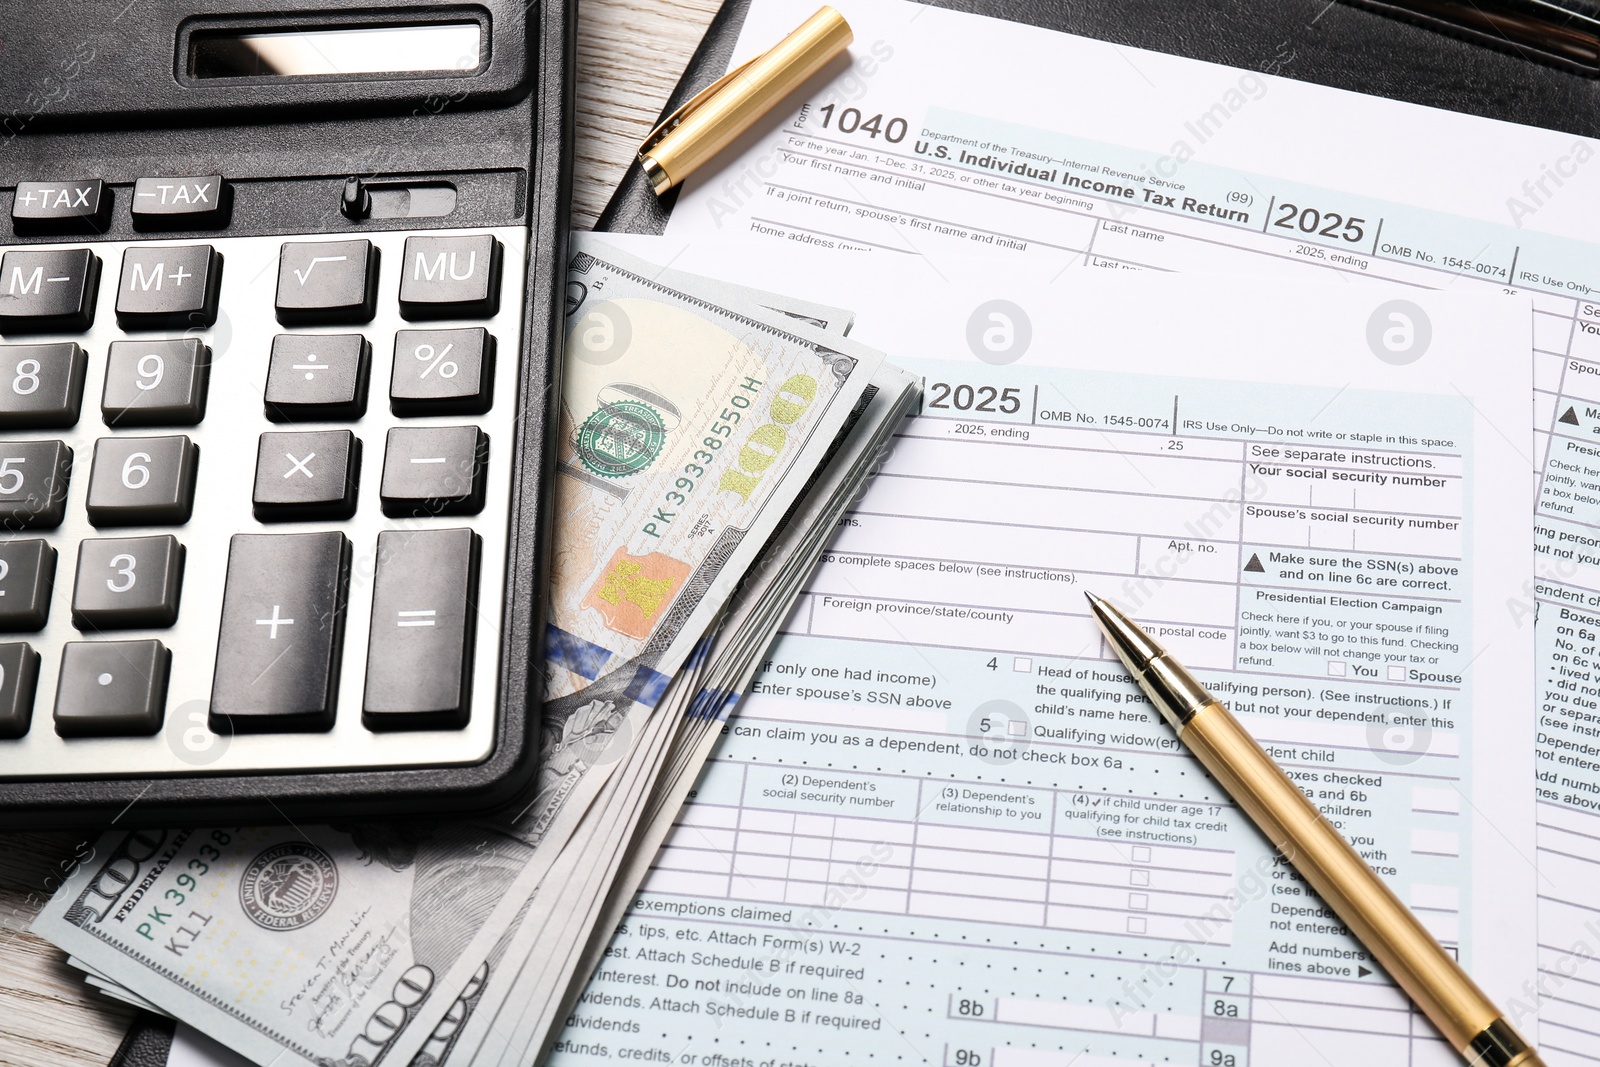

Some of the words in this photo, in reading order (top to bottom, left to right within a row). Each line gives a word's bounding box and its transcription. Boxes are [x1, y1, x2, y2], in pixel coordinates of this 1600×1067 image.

[794, 103, 811, 129] Form
[820, 103, 908, 143] 1040
[921, 128, 978, 147] Department
[980, 142, 991, 150] of
[992, 144, 1008, 154] the
[1011, 147, 1100, 173] Treasury—Internal
[1102, 167, 1146, 183] Revenue
[1148, 176, 1186, 191] Service
[783, 153, 808, 166] Your
[811, 159, 832, 172] first
[834, 166, 867, 179] name
[870, 174, 893, 185] and
[895, 177, 926, 192] initial
[914, 141, 952, 161] U.S.
[959, 150, 1057, 183] Individual
[1062, 172, 1135, 199] Income
[1143, 188, 1176, 208] Tax
[1182, 197, 1249, 224] Return
[1226, 190, 1254, 208] (99)
[767, 187, 776, 196] If
[786, 194, 812, 205] joint
[814, 199, 851, 214] return,
[855, 209, 907, 225] spouse's
[910, 218, 932, 231] first
[934, 225, 968, 239] name
[970, 234, 994, 244] and
[996, 237, 1028, 251] initial
[1102, 221, 1127, 236] Last
[1131, 228, 1165, 242] name
[1274, 203, 1366, 243] 2025
[750, 222, 785, 238] Home
[788, 233, 835, 249] address
[413, 250, 476, 281] MU
[1296, 245, 1327, 260] 2025,
[1330, 254, 1369, 270] ending
[1381, 244, 1412, 258] OMB
[1416, 250, 1436, 263] No.
[1443, 257, 1506, 278] 1545-0074
[12, 359, 41, 395] 8
[135, 354, 165, 390] 9
[929, 382, 1021, 414] 2025
[1040, 410, 1072, 422] OMB
[1076, 413, 1097, 424] No.
[1104, 415, 1169, 429] 1545-0074
[717, 373, 818, 507] 100
[955, 424, 987, 436] 2025,
[991, 428, 1030, 441] ending
[1183, 420, 1203, 430] IRS
[1206, 422, 1228, 432] Use
[1231, 424, 1284, 436] Only—Do
[1287, 429, 1304, 437] not
[1307, 430, 1333, 439] write
[1350, 433, 1383, 444] staple
[1386, 435, 1396, 443] in
[1399, 436, 1418, 445] this
[1421, 439, 1457, 448] space.
[1168, 440, 1184, 451] 25
[1252, 445, 1280, 458] See
[1285, 450, 1346, 463] separate
[1352, 454, 1436, 469] instructions.
[121, 452, 152, 489] 6
[1249, 463, 1282, 476] Your
[1286, 469, 1327, 479] social
[1332, 472, 1388, 486] security
[1393, 476, 1447, 488] number
[1550, 458, 1581, 474] Check
[1246, 506, 1306, 520] Spouse's
[1311, 512, 1349, 523] social
[1353, 516, 1405, 529] security
[1409, 520, 1459, 531] number
[1541, 500, 1575, 515] refund.
[688, 513, 709, 539] SERIES
[1168, 540, 1193, 553] Apt.
[1198, 545, 1217, 553] no.
[106, 554, 137, 593] 3
[1270, 552, 1305, 565] Make
[1309, 558, 1338, 567] sure
[1342, 558, 1363, 569] the
[1367, 559, 1414, 575] SSN(s)
[1419, 564, 1459, 576] above
[1279, 570, 1304, 580] and
[1308, 573, 1324, 581] on
[1329, 572, 1352, 584] line
[1356, 574, 1372, 585] 6c
[1376, 578, 1398, 587] are
[1402, 580, 1451, 591] correct.
[823, 596, 872, 612] Foreign
[876, 603, 1014, 624] province/state/county
[1257, 591, 1326, 605] Presidential
[1330, 596, 1378, 609] Election
[1382, 601, 1443, 616] Campaign
[1557, 626, 1573, 637] on
[1578, 628, 1596, 642] 6a
[1555, 638, 1577, 652] No.
[1582, 644, 1594, 656] of
[763, 660, 773, 673] if
[776, 664, 807, 678] only
[811, 668, 839, 678] one
[844, 667, 872, 681] had
[877, 673, 936, 689] income)
[987, 658, 998, 671] 4
[1352, 665, 1378, 678] You
[1409, 670, 1462, 686] Spouse
[752, 681, 791, 696] Enter
[796, 688, 862, 702] spouse's
[867, 691, 901, 705] SSN
[906, 695, 952, 710] above
[980, 719, 991, 732] 5
[1034, 726, 1106, 745] Qualifying
[1110, 733, 1184, 751] widow(er)
[1301, 748, 1335, 763] child
[536, 772, 578, 832] FRANKLIN
[763, 789, 797, 799] social
[801, 792, 847, 806] security
[849, 797, 895, 808] number
[244, 868, 260, 905] UNITED
[254, 910, 300, 927] FEDERAL
[302, 883, 333, 922] RESERVE
[164, 910, 213, 957] K11
[763, 934, 824, 955] Form(s)
[829, 941, 861, 956] W-2
[1268, 958, 1302, 972] lines
[1307, 962, 1351, 977] above
[1222, 977, 1234, 992] 7
[959, 998, 984, 1017] 8b
[1214, 1000, 1238, 1017] 8a
